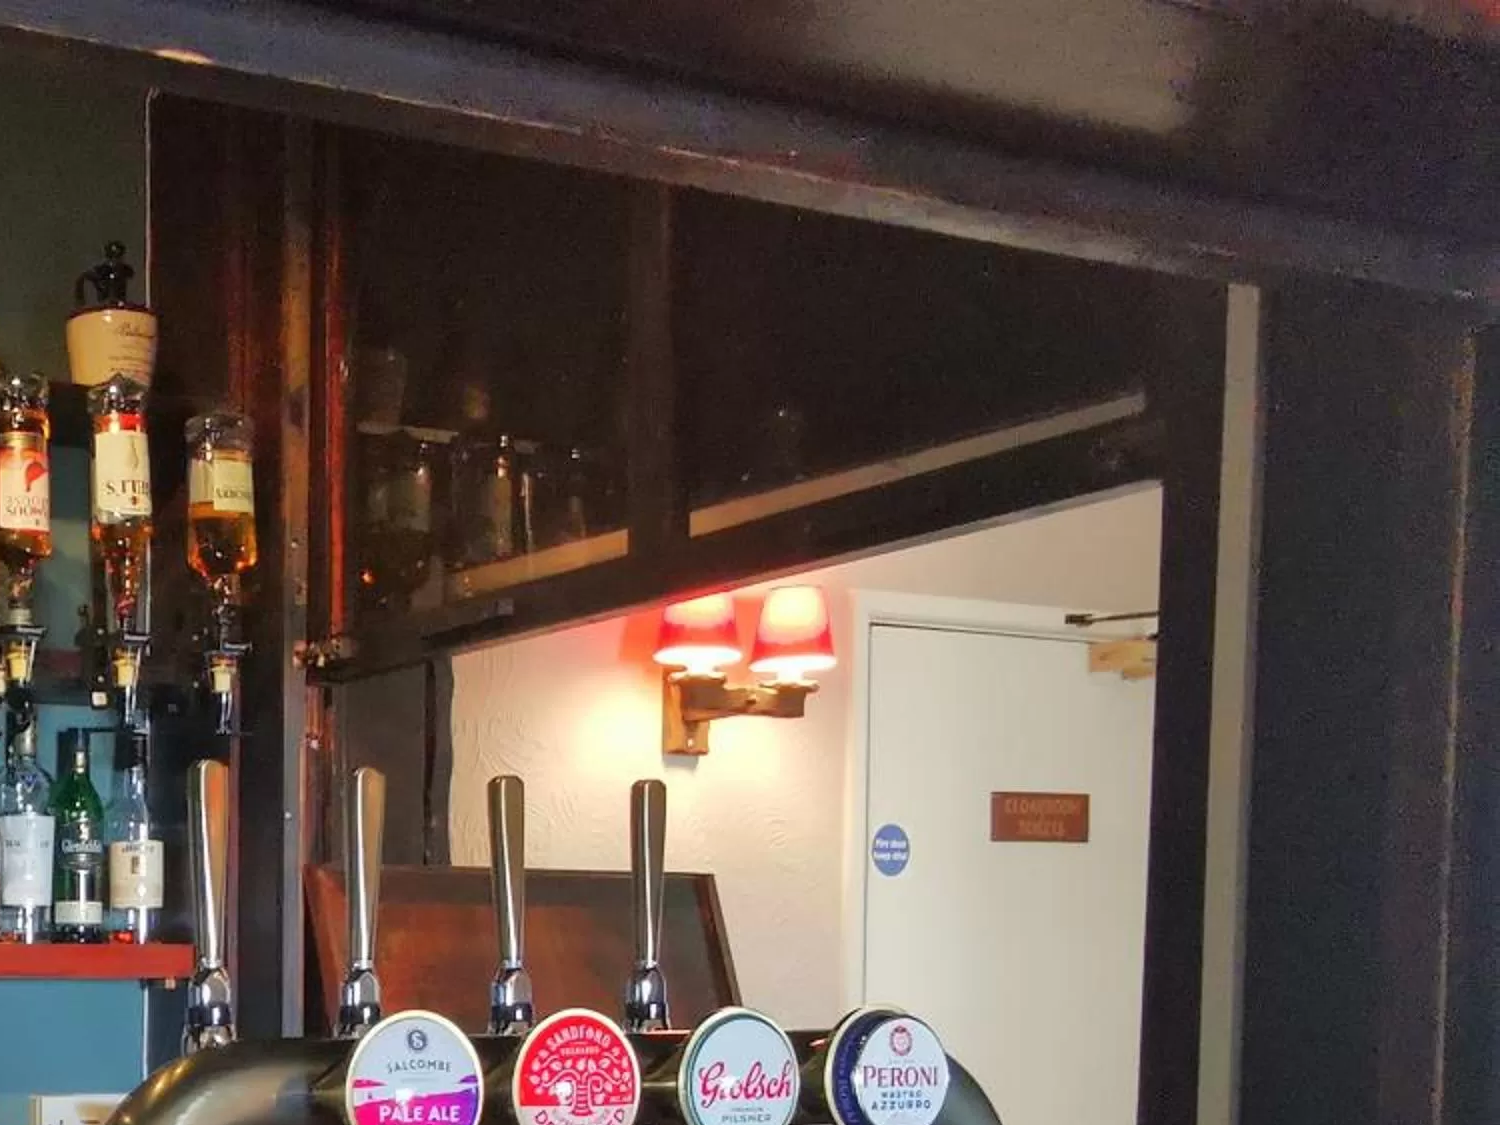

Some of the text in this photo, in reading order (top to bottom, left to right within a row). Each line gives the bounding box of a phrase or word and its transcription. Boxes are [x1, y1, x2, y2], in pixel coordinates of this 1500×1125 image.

[546, 1024, 611, 1052] SANDFORD
[387, 1059, 452, 1075] SALCOMBE
[698, 1060, 792, 1109] Grolsch
[863, 1065, 938, 1089] PERONI
[881, 1090, 922, 1099] NASTRO
[379, 1104, 461, 1123] PALE ALE
[872, 1100, 932, 1111] AZZURRO
[721, 1114, 772, 1124] PILSNER
